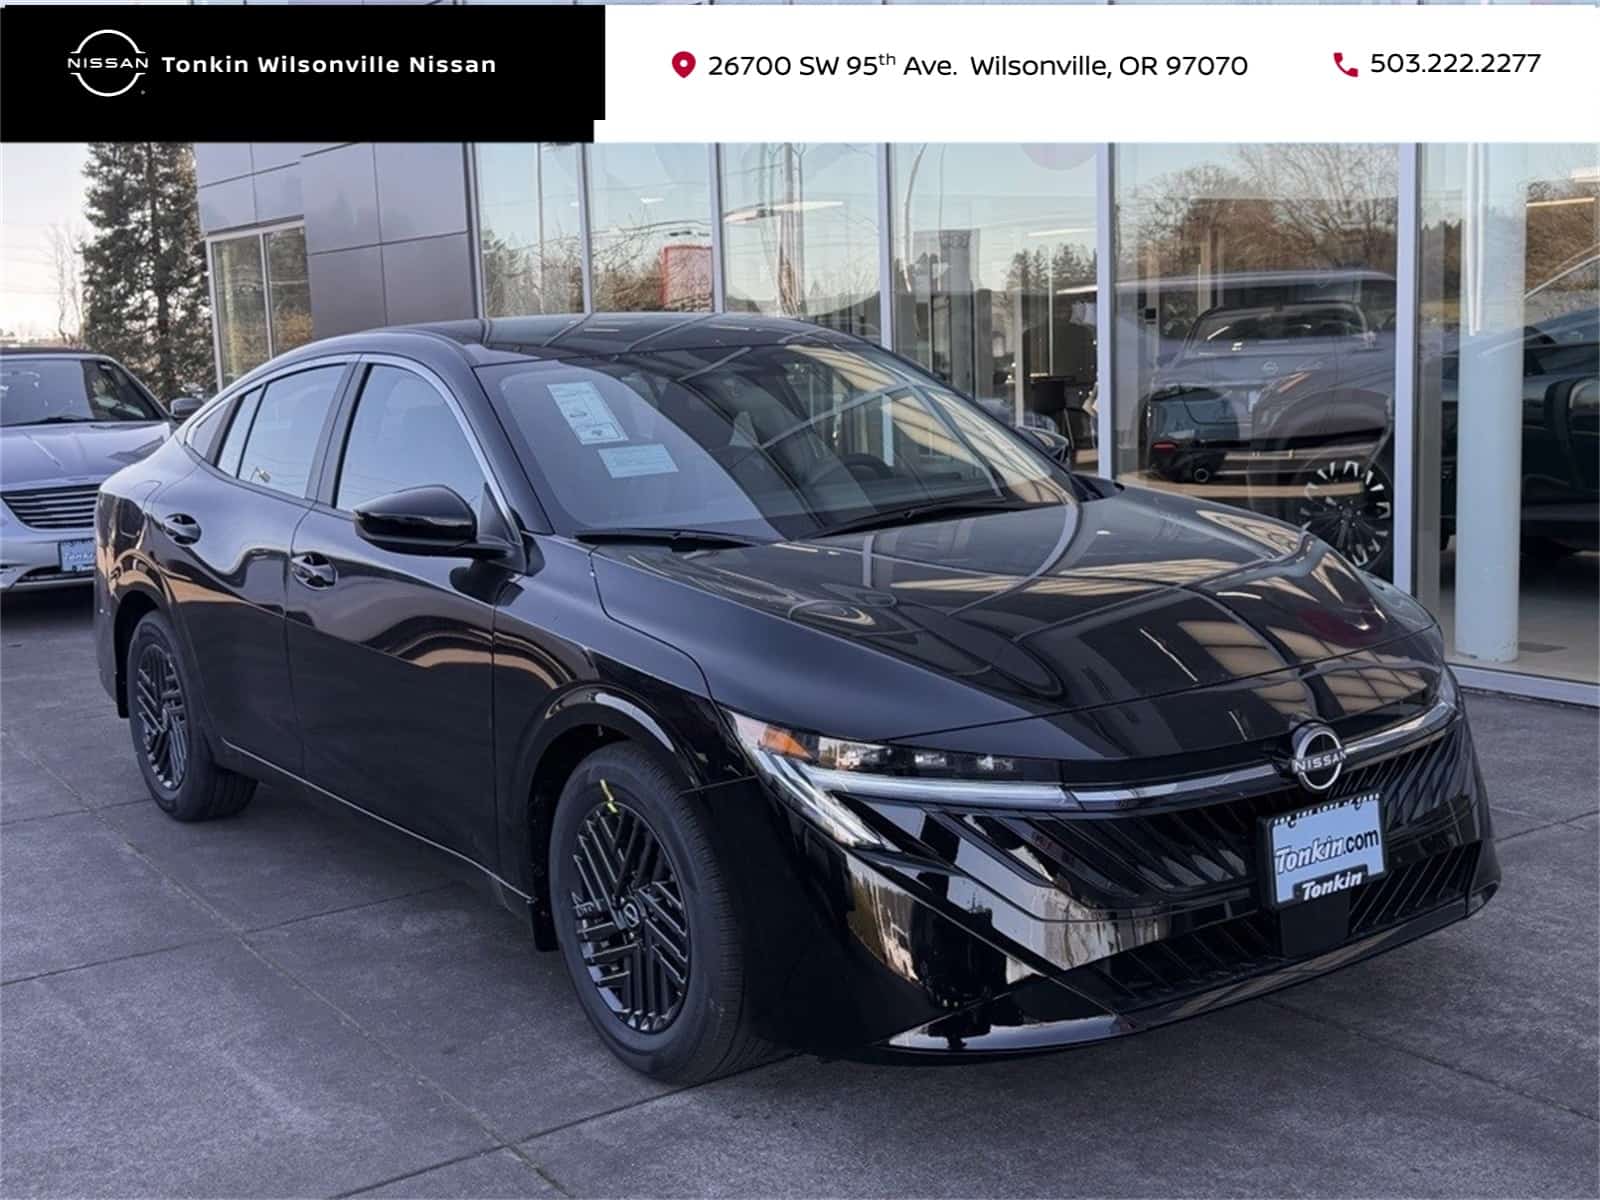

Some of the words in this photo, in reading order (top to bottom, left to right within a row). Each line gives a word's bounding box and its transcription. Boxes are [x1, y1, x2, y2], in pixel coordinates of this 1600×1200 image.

[1295, 751, 1346, 772] NISSAN
[1275, 830, 1379, 875] Tonkin.com
[1302, 872, 1363, 901] Tonkin
